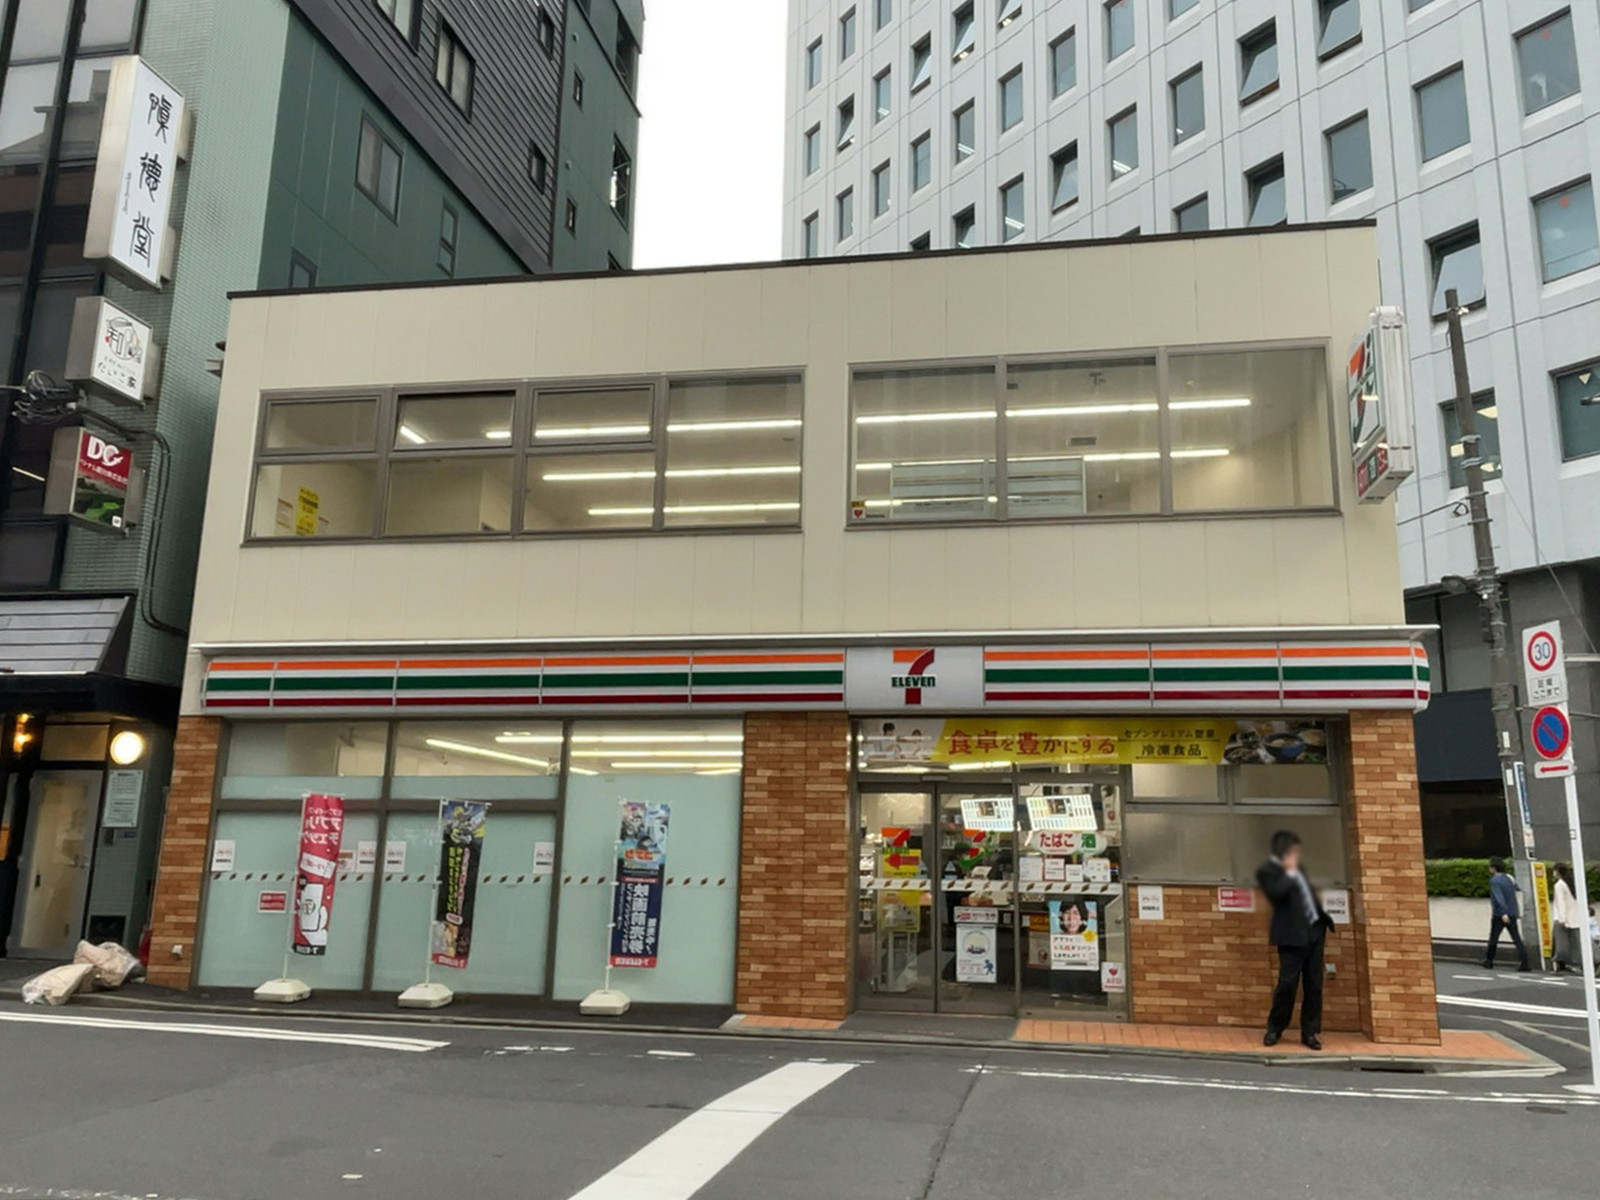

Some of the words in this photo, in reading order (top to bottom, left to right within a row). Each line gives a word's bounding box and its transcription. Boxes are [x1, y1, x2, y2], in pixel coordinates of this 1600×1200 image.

[1534, 641, 1551, 661] 30
[948, 729, 1117, 755] 食卓を豊かにする
[1141, 743, 1203, 757] 冷凍食品
[1039, 832, 1076, 848] たばこ
[1081, 833, 1096, 848] 酒
